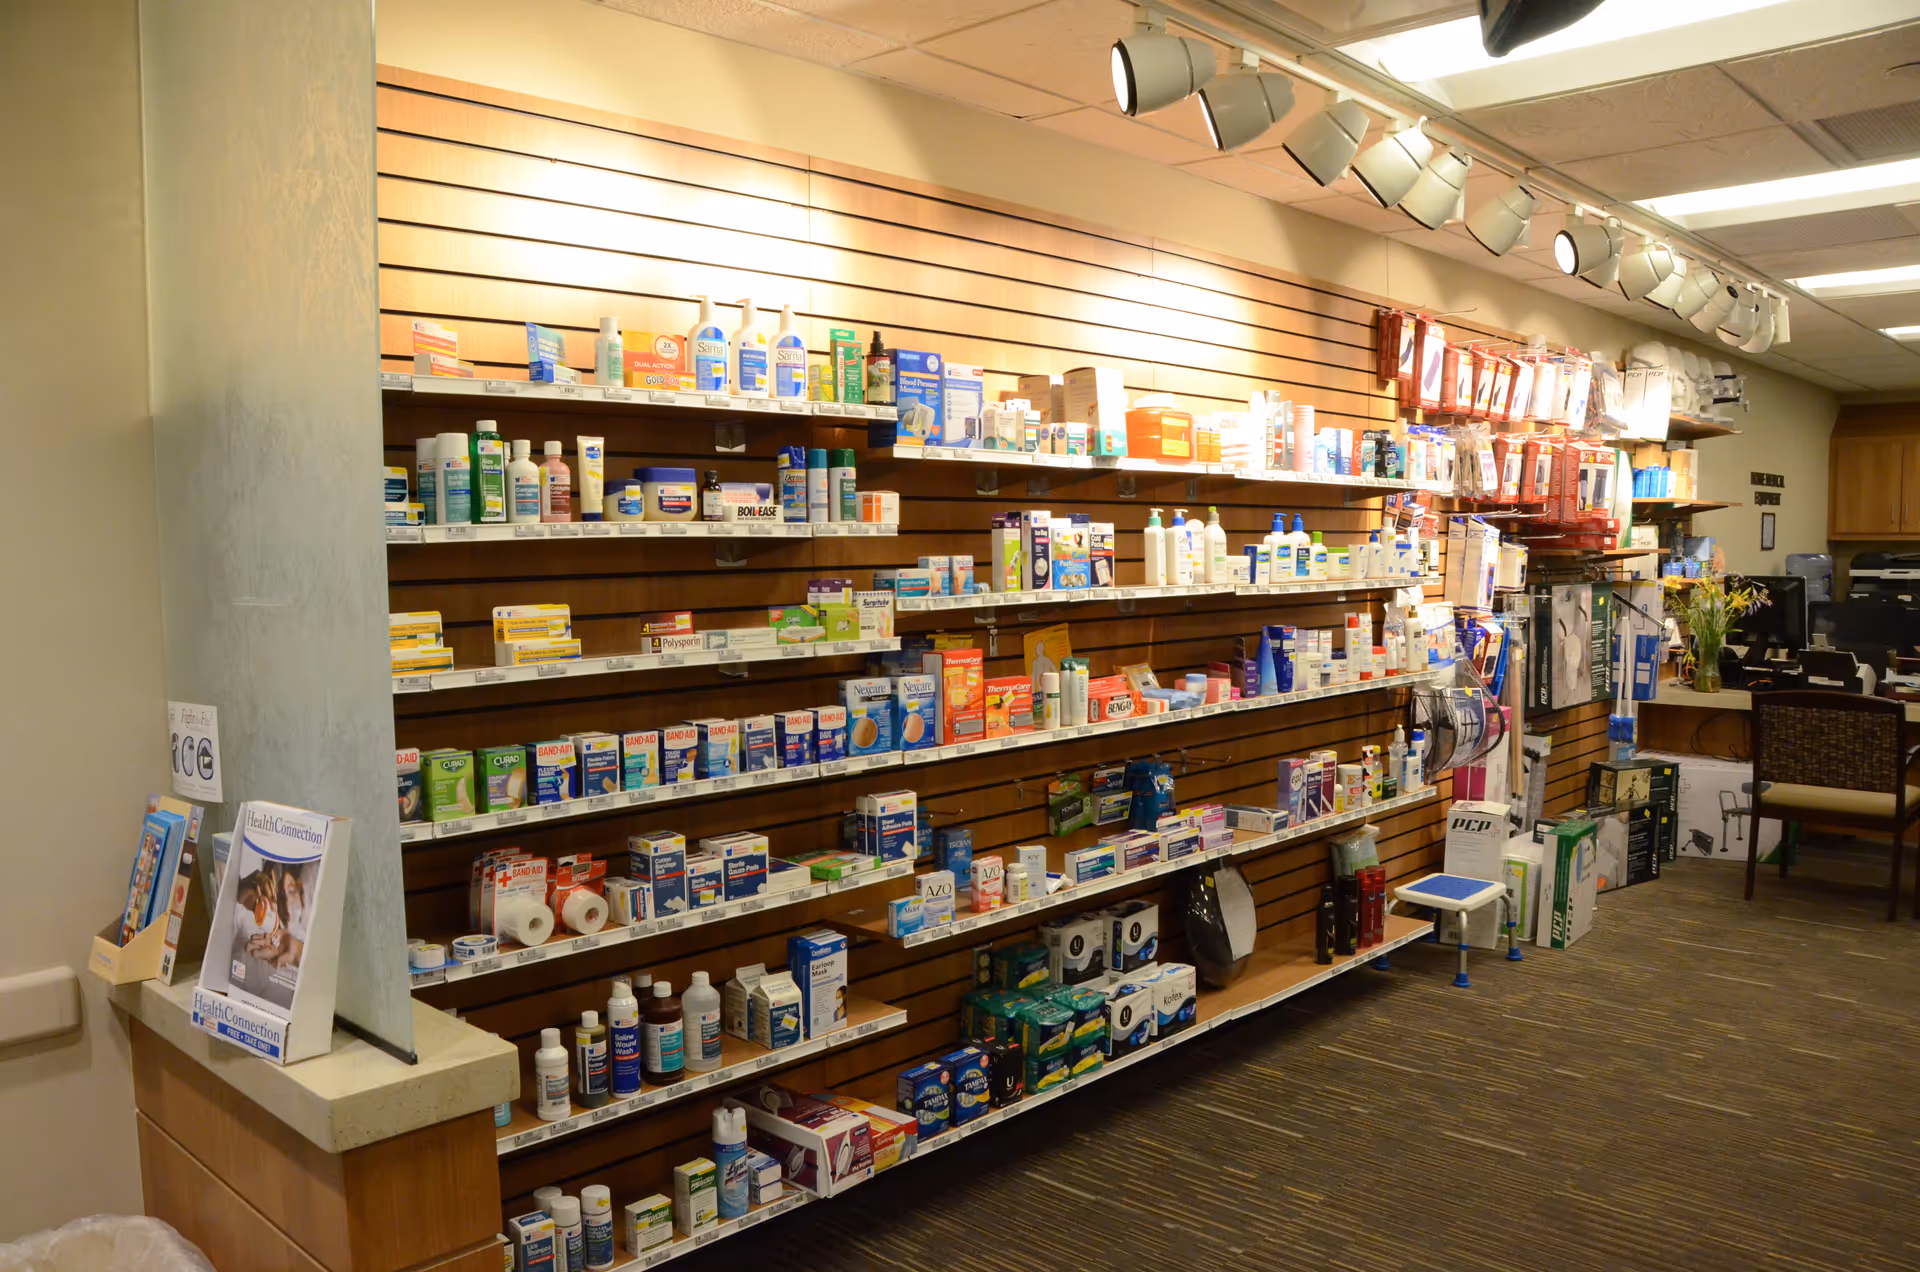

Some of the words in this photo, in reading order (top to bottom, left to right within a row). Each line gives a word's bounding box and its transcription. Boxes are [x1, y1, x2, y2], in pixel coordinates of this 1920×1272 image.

[698, 341, 724, 354] Sarna
[778, 350, 802, 362] Sarna
[634, 360, 651, 368] DUAL
[652, 362, 675, 370] ACTION
[645, 374, 664, 386] GOLD
[665, 374, 681, 386] BON
[900, 377, 916, 387] Blood
[662, 636, 700, 648] Polysporin
[945, 656, 982, 665] ThermaCare
[854, 684, 886, 696] Nexcare
[904, 682, 932, 692] Nexcare
[987, 683, 1031, 693] ThermaCare
[1107, 699, 1134, 714] BENGAY
[786, 714, 812, 726] BAND-AID
[820, 712, 844, 724] BAND-AID
[666, 729, 696, 741] BAND-AID
[709, 724, 737, 736] BAND-AID
[625, 734, 656, 747] BAND-AID
[538, 745, 573, 757] BAND-AID
[396, 752, 418, 764] D-AID
[442, 759, 465, 768] CURAD
[493, 755, 520, 766] CURAD
[248, 810, 323, 845] HealthConnection
[1451, 818, 1492, 831] PCP
[512, 865, 544, 878] BAND-AID
[981, 864, 1001, 880] AZO
[926, 883, 952, 898] AZO
[904, 906, 920, 914] Midol
[1552, 911, 1563, 940] PCP
[812, 960, 835, 971] Earloop
[812, 968, 828, 977] Mask
[1163, 991, 1184, 1006] Kotex
[194, 992, 280, 1043] HealthConnection
[226, 1026, 240, 1040] FREE
[244, 1032, 257, 1046] TAKE
[615, 1040, 637, 1048] Wound
[964, 1076, 988, 1092] TAMPAX
[924, 1092, 949, 1109] TAMPAX
